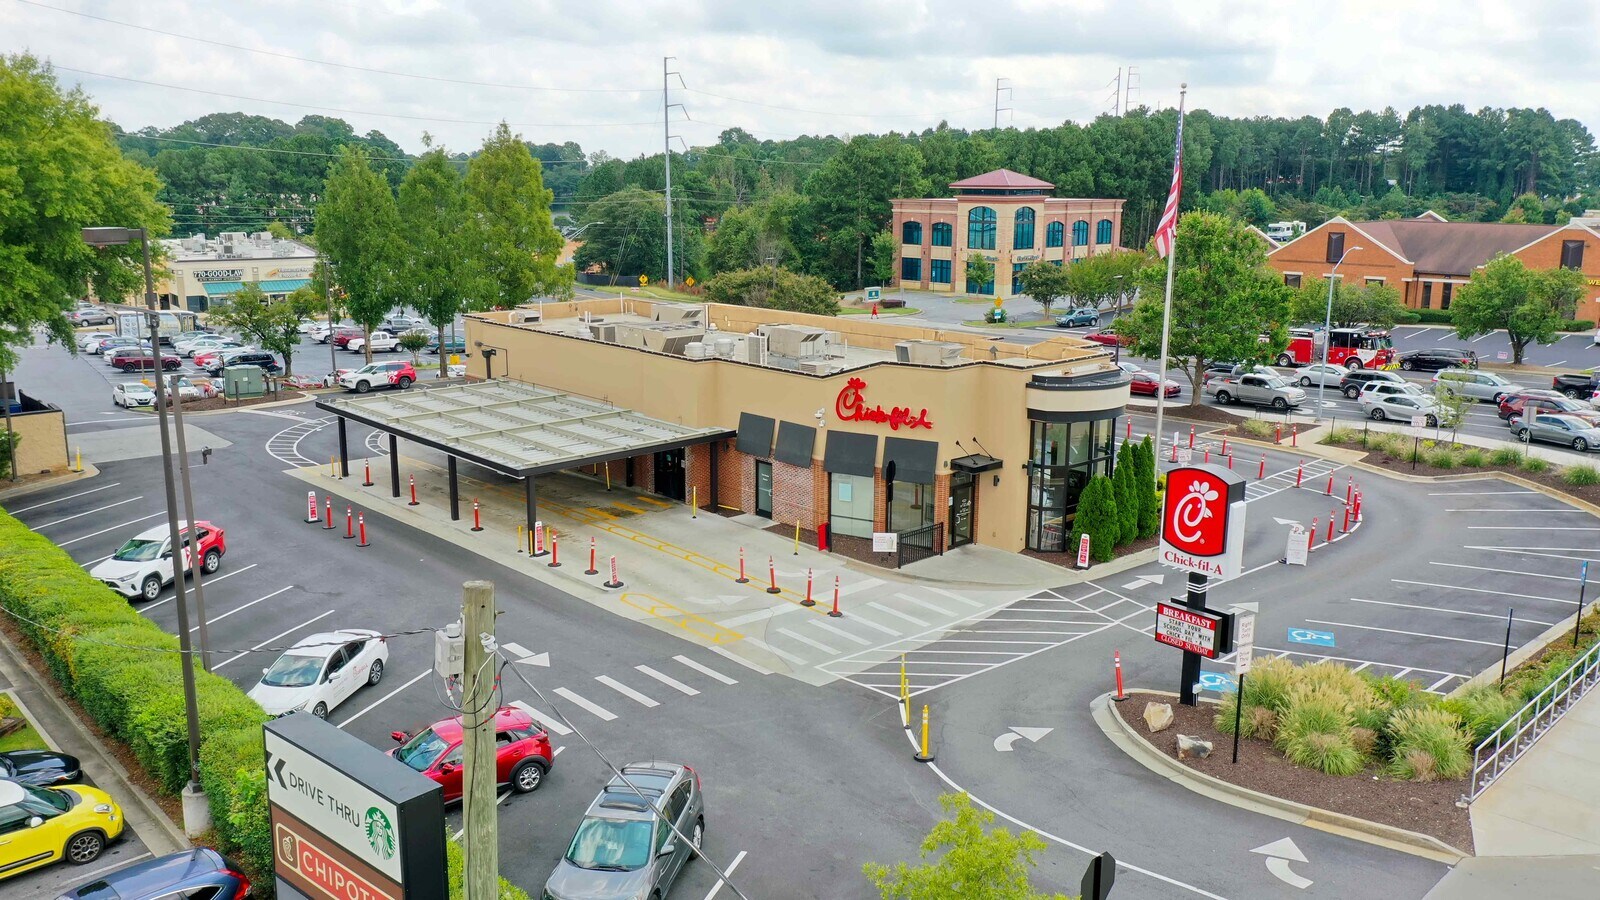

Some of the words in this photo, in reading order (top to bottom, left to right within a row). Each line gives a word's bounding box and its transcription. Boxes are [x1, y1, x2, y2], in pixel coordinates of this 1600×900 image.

[193, 269, 244, 278] 770-GOOD-LAW
[836, 377, 932, 431] Chick-fil-A
[1164, 551, 1223, 575] Chick-fil-A
[1163, 606, 1211, 629] BREAKFAST
[1168, 618, 1184, 627] START
[1187, 623, 1202, 633] YOUR
[1163, 622, 1182, 633] SCHOOL
[1184, 628, 1195, 636] DAY
[1198, 633, 1211, 642] WITH
[1161, 634, 1184, 647] CLOSED
[1185, 642, 1209, 655] SUNDAY
[289, 772, 324, 806] DRIVE
[327, 795, 360, 828] THRU
[303, 851, 376, 900] CHIPOT
